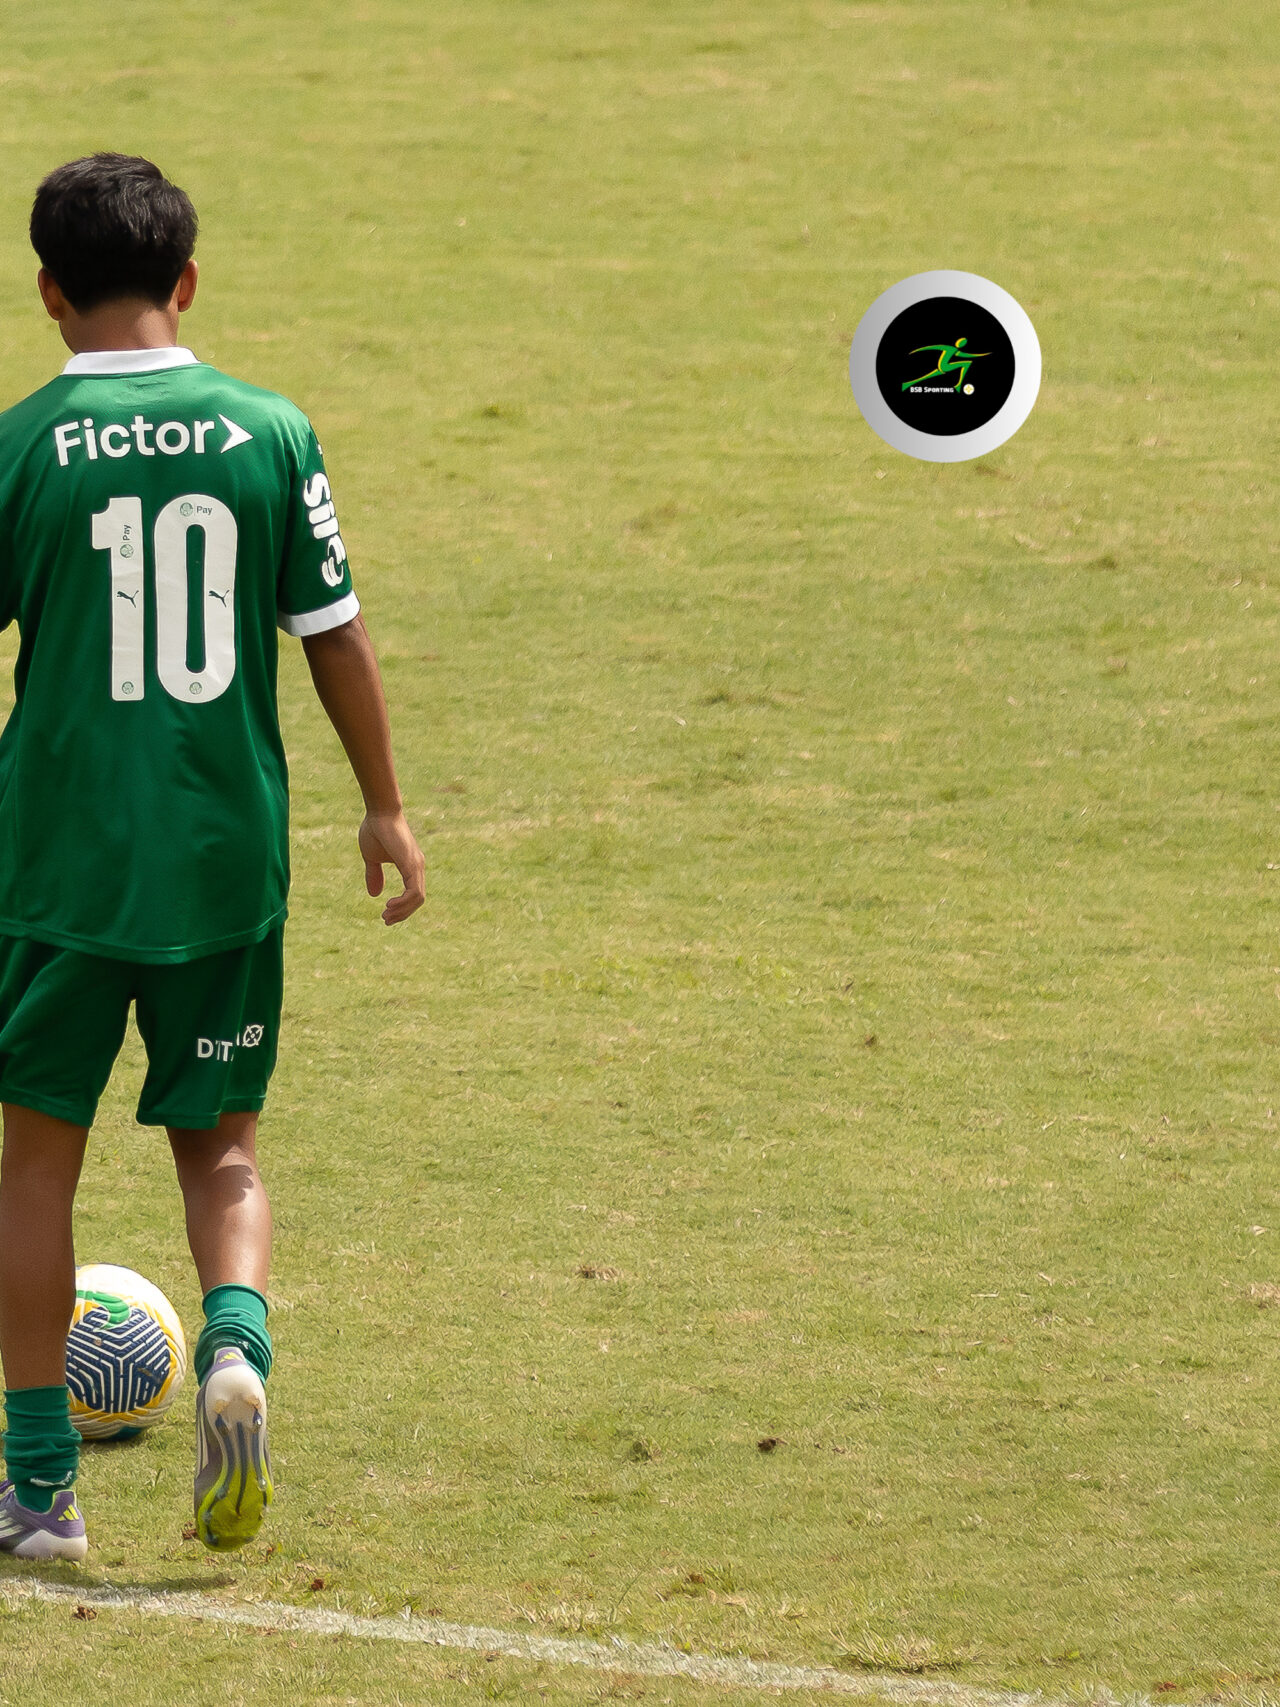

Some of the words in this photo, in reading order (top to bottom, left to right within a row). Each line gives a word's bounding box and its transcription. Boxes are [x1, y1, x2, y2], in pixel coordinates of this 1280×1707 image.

[54, 415, 215, 467] Fictor
[196, 505, 213, 515] Pay
[122, 524, 132, 541] Pay
[91, 493, 238, 704] 10
